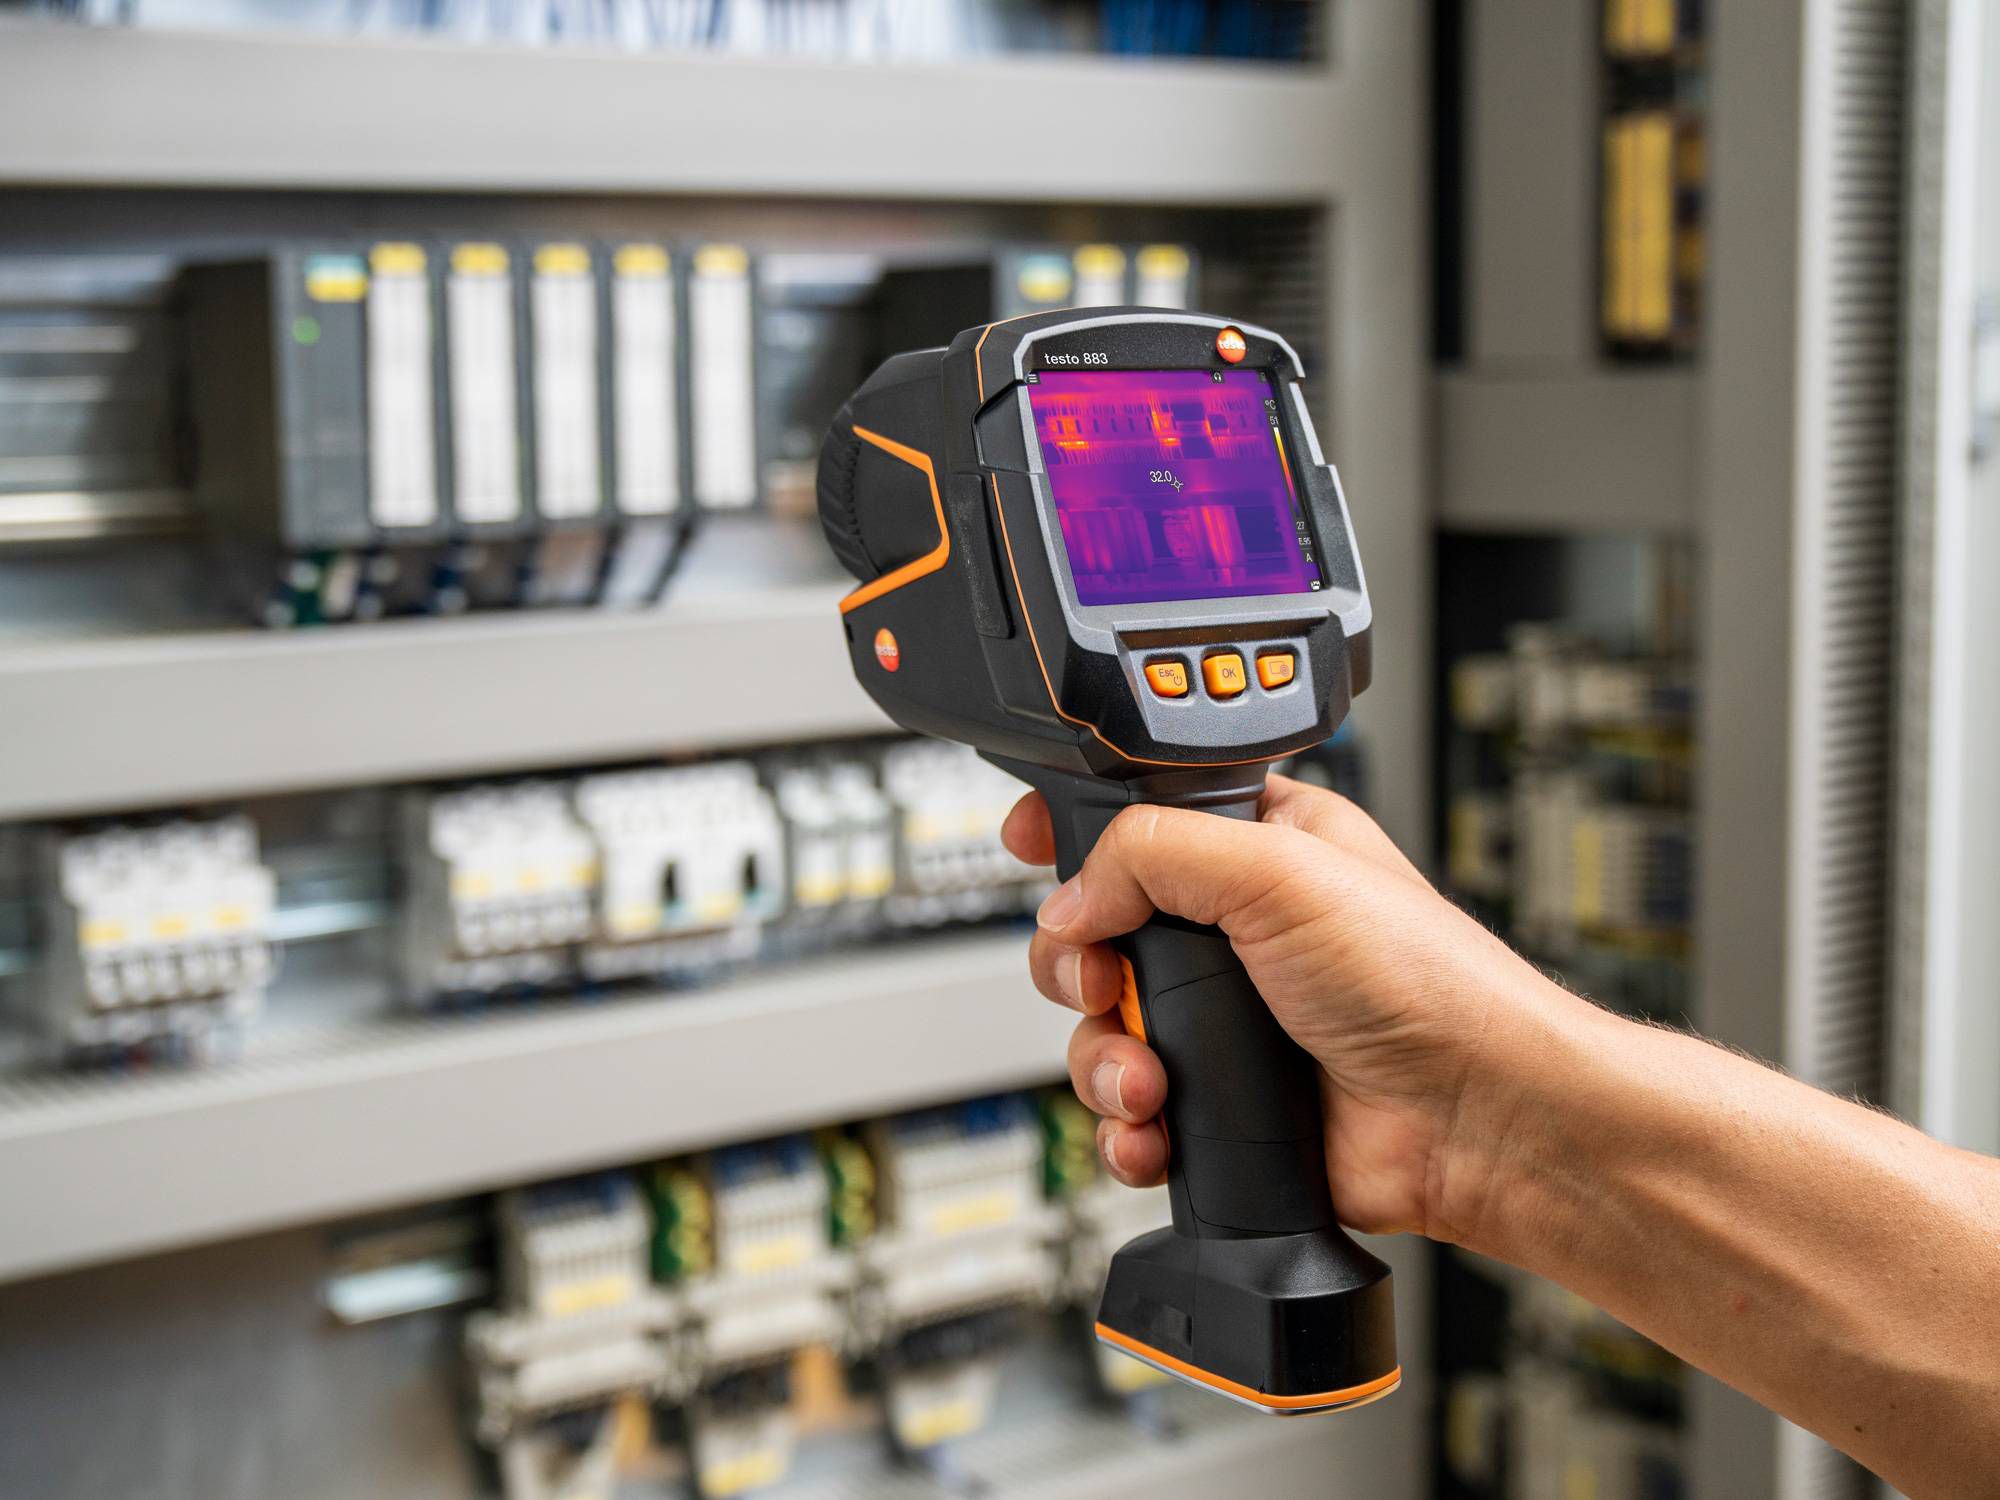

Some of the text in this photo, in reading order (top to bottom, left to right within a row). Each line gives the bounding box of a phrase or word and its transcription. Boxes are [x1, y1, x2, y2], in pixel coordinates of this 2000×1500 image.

[1044, 352, 1108, 364] testo 883
[1149, 470, 1172, 482] 32.0
[1306, 553, 1313, 562] A
[1158, 668, 1175, 677] Esc
[1222, 667, 1236, 679] OK
